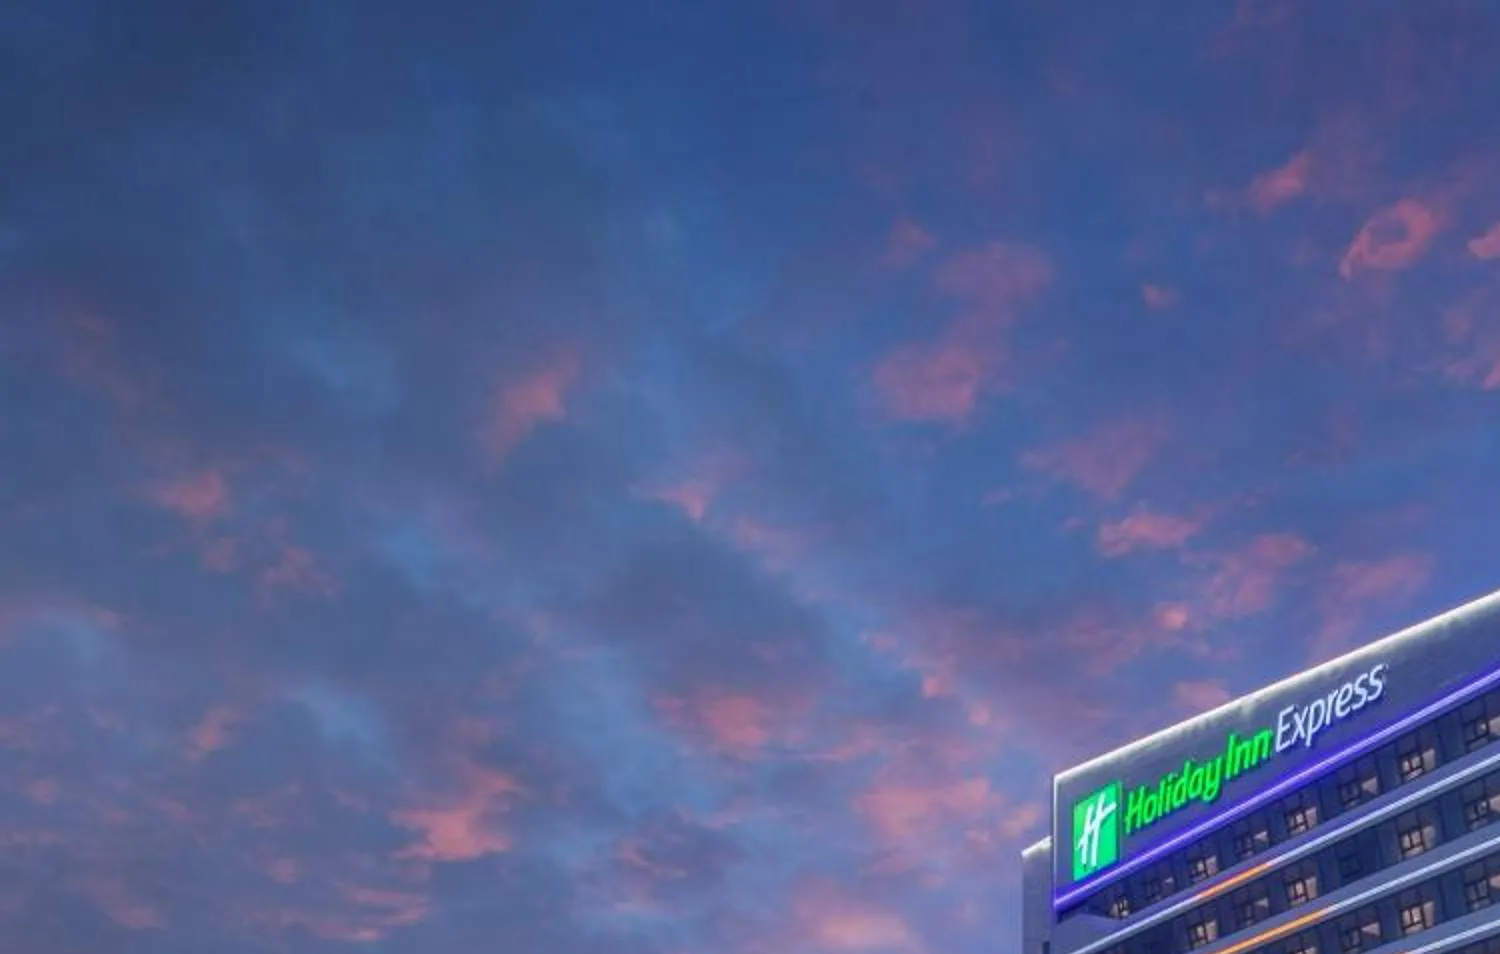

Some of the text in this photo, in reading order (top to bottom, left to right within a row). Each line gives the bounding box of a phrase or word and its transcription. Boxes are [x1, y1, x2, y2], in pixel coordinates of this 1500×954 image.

[1123, 663, 1385, 834] Holiday Inn Express
